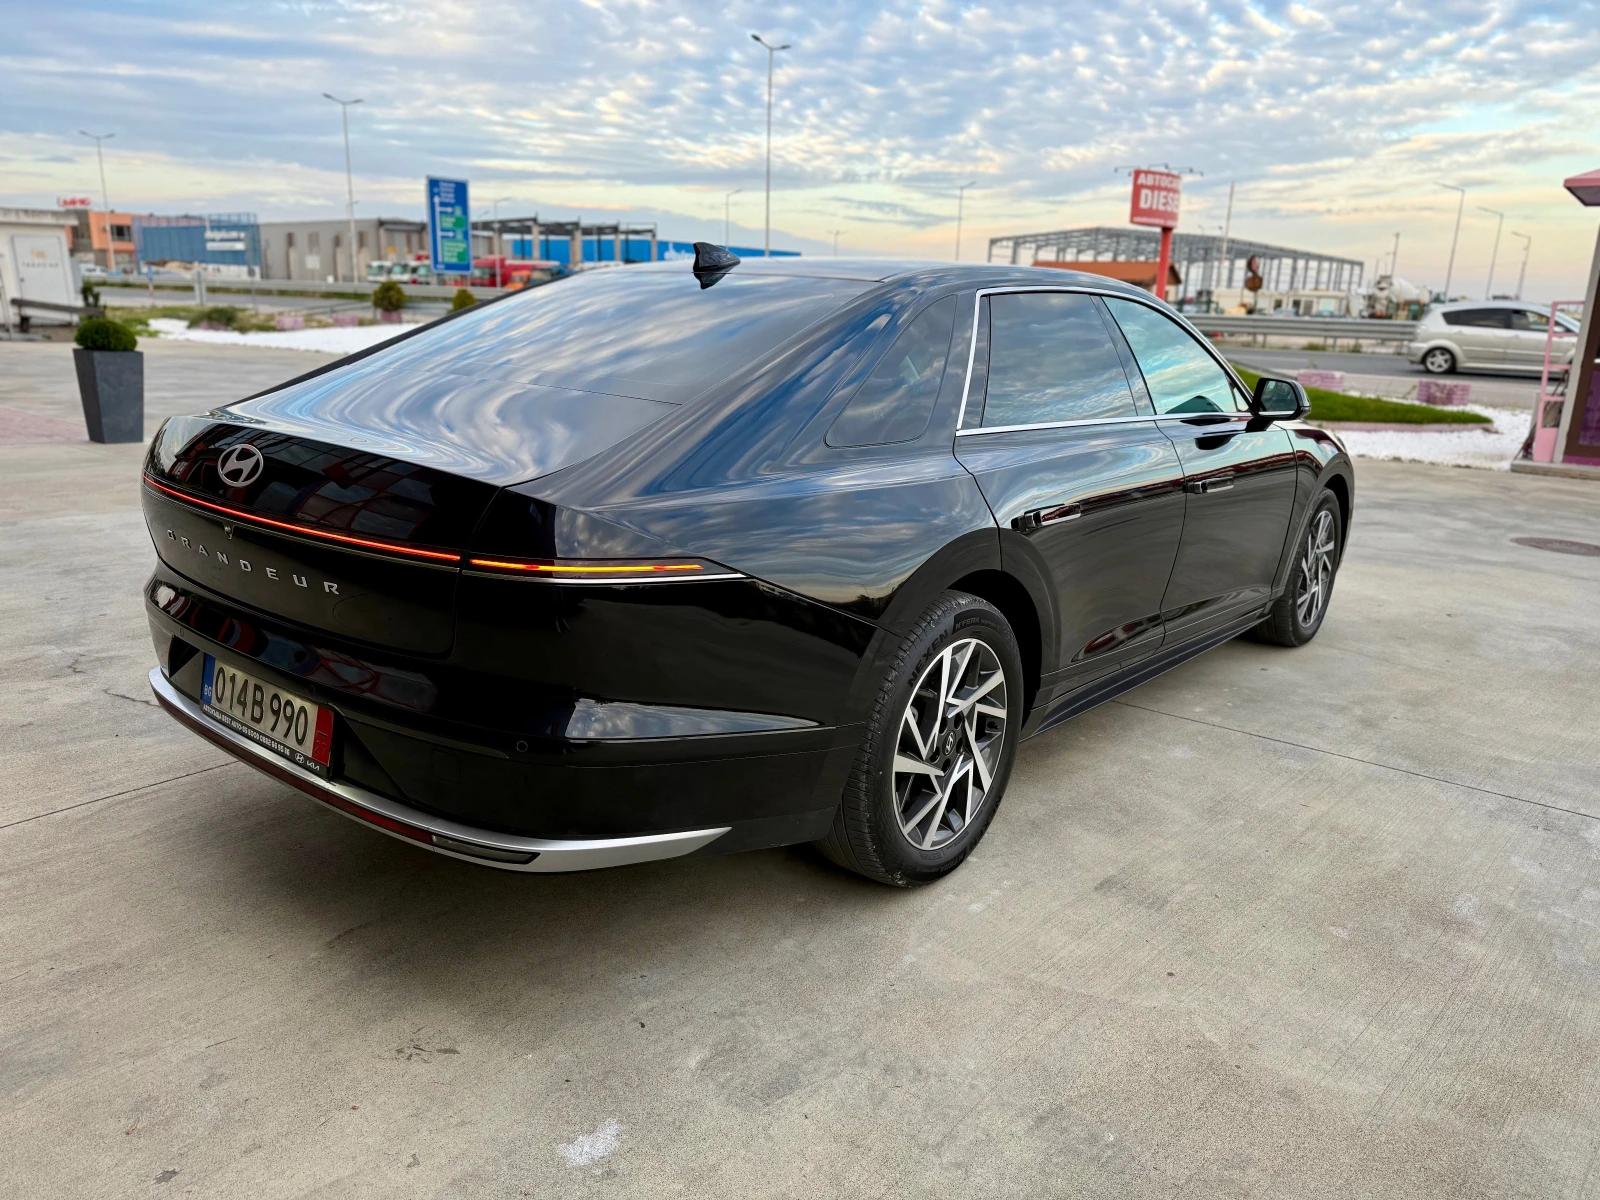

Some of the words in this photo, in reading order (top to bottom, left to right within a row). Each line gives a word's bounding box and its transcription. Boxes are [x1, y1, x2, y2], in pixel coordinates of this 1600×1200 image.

[167, 529, 340, 595] GRANDEUR
[907, 628, 949, 687] NEXEN
[204, 684, 213, 698] BG
[306, 760, 320, 771] KIA
